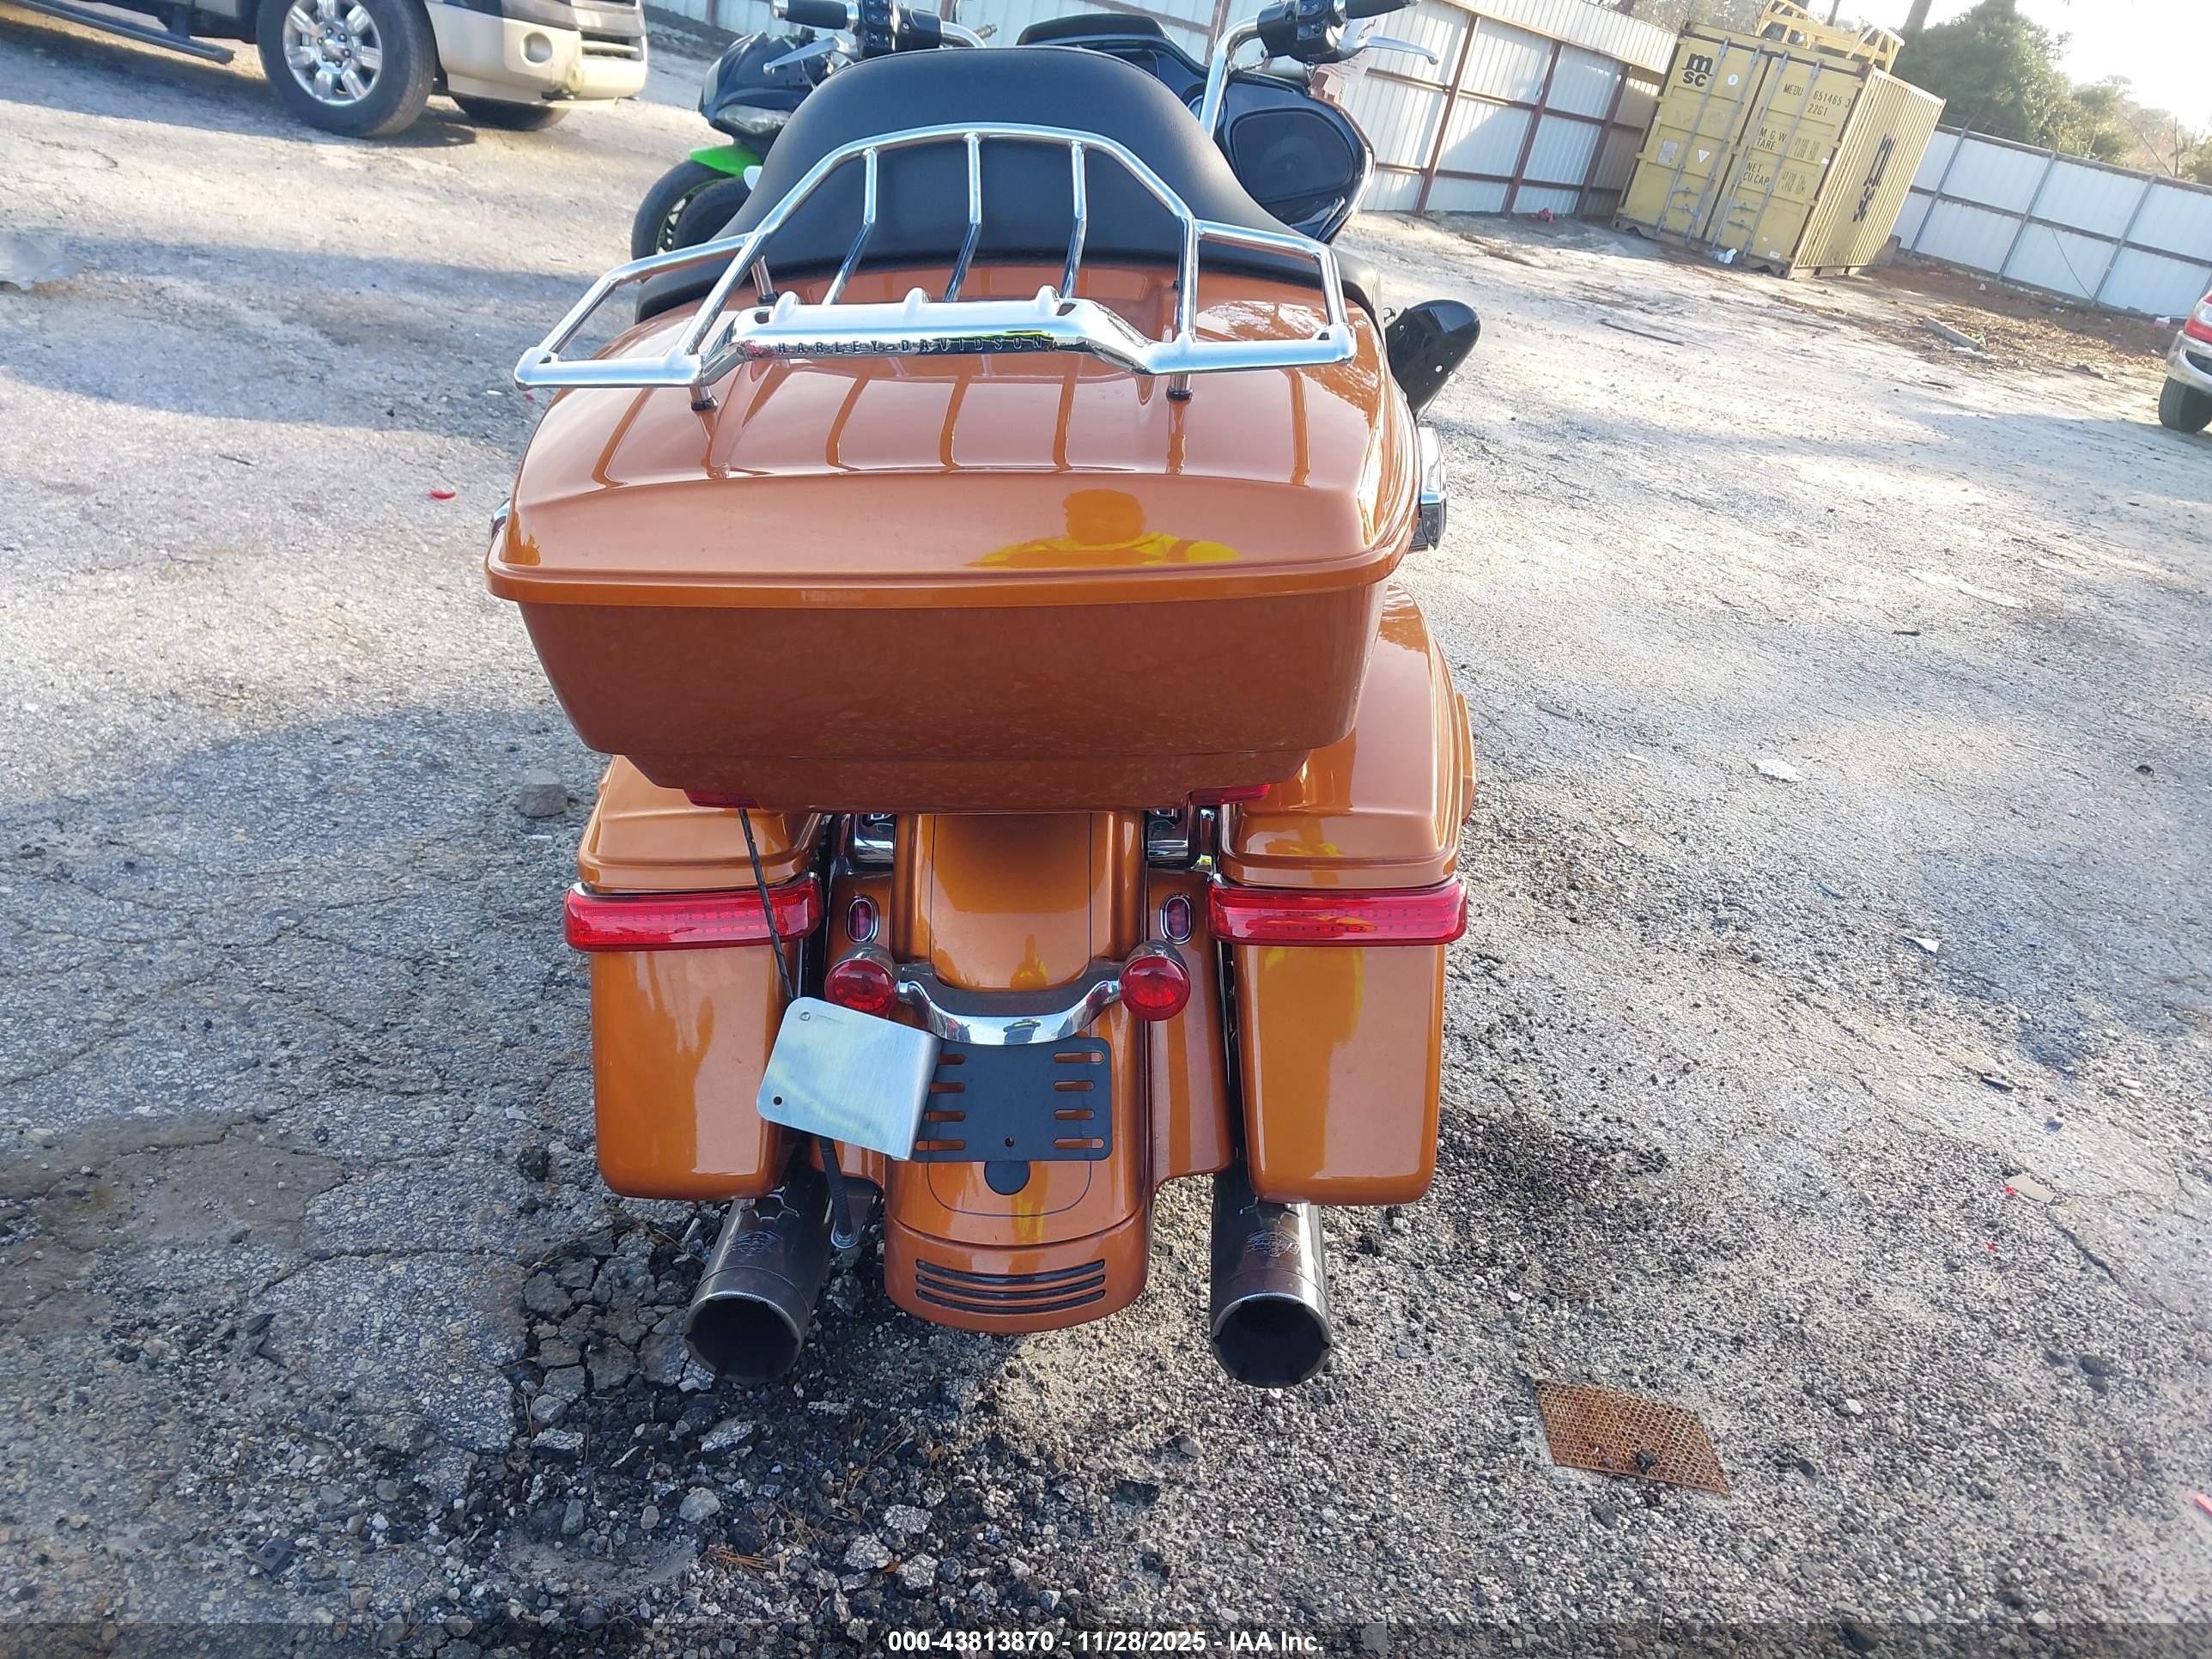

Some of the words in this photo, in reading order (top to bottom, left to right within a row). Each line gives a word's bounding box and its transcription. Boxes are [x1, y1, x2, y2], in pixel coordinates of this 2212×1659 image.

[1783, 83, 1804, 96] MEDU
[1813, 90, 1842, 106] 651465
[1757, 137, 1777, 151] TARE
[1746, 161, 1763, 173] NET
[777, 336, 1043, 354] HARLEY-DAVIDSON
